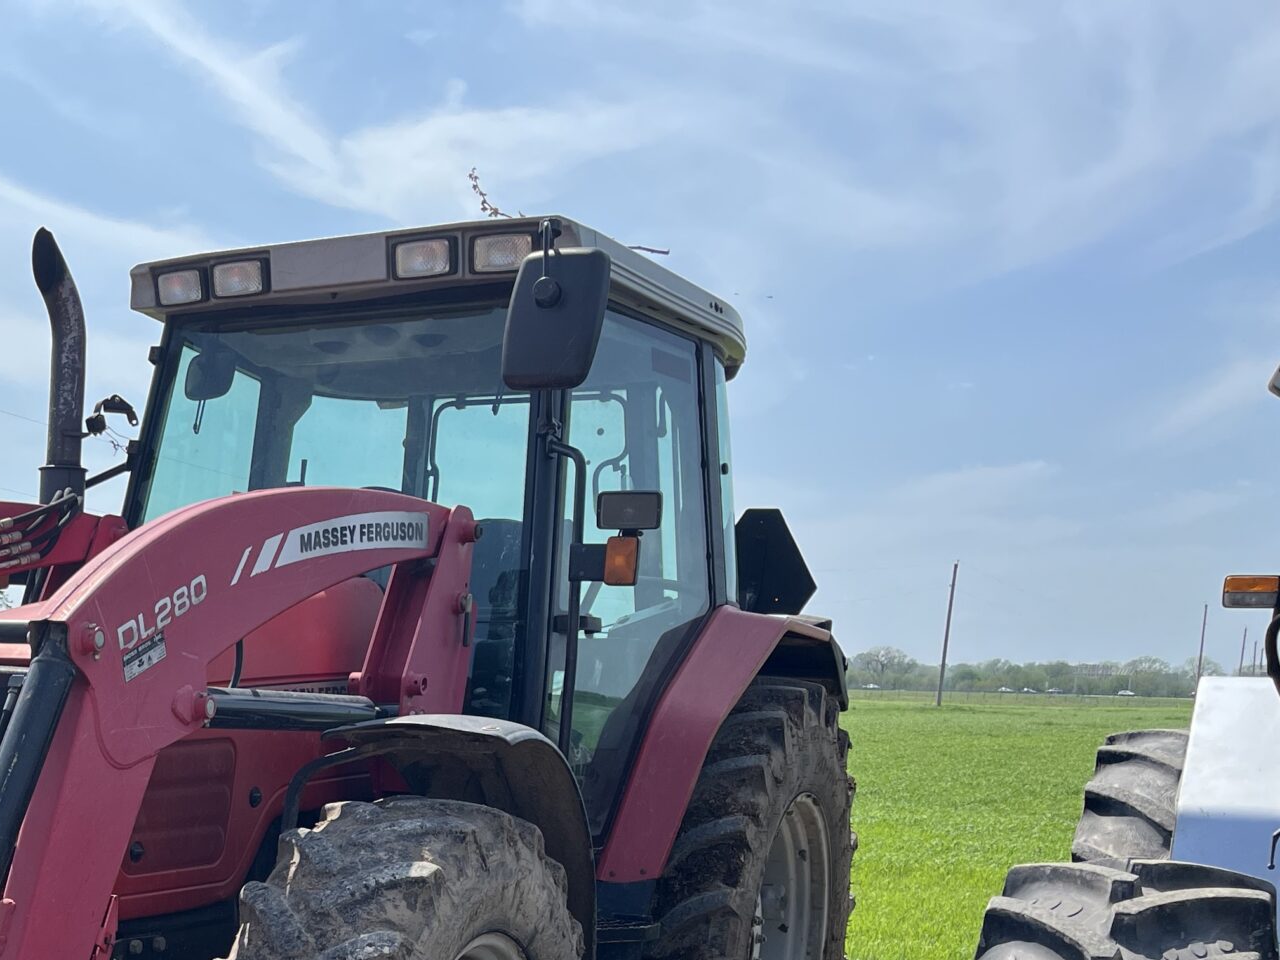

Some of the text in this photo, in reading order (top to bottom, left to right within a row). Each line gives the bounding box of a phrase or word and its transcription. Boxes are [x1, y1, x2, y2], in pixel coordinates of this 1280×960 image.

[300, 522, 424, 553] MASSEY FERGUSON
[117, 574, 207, 650] DL280
